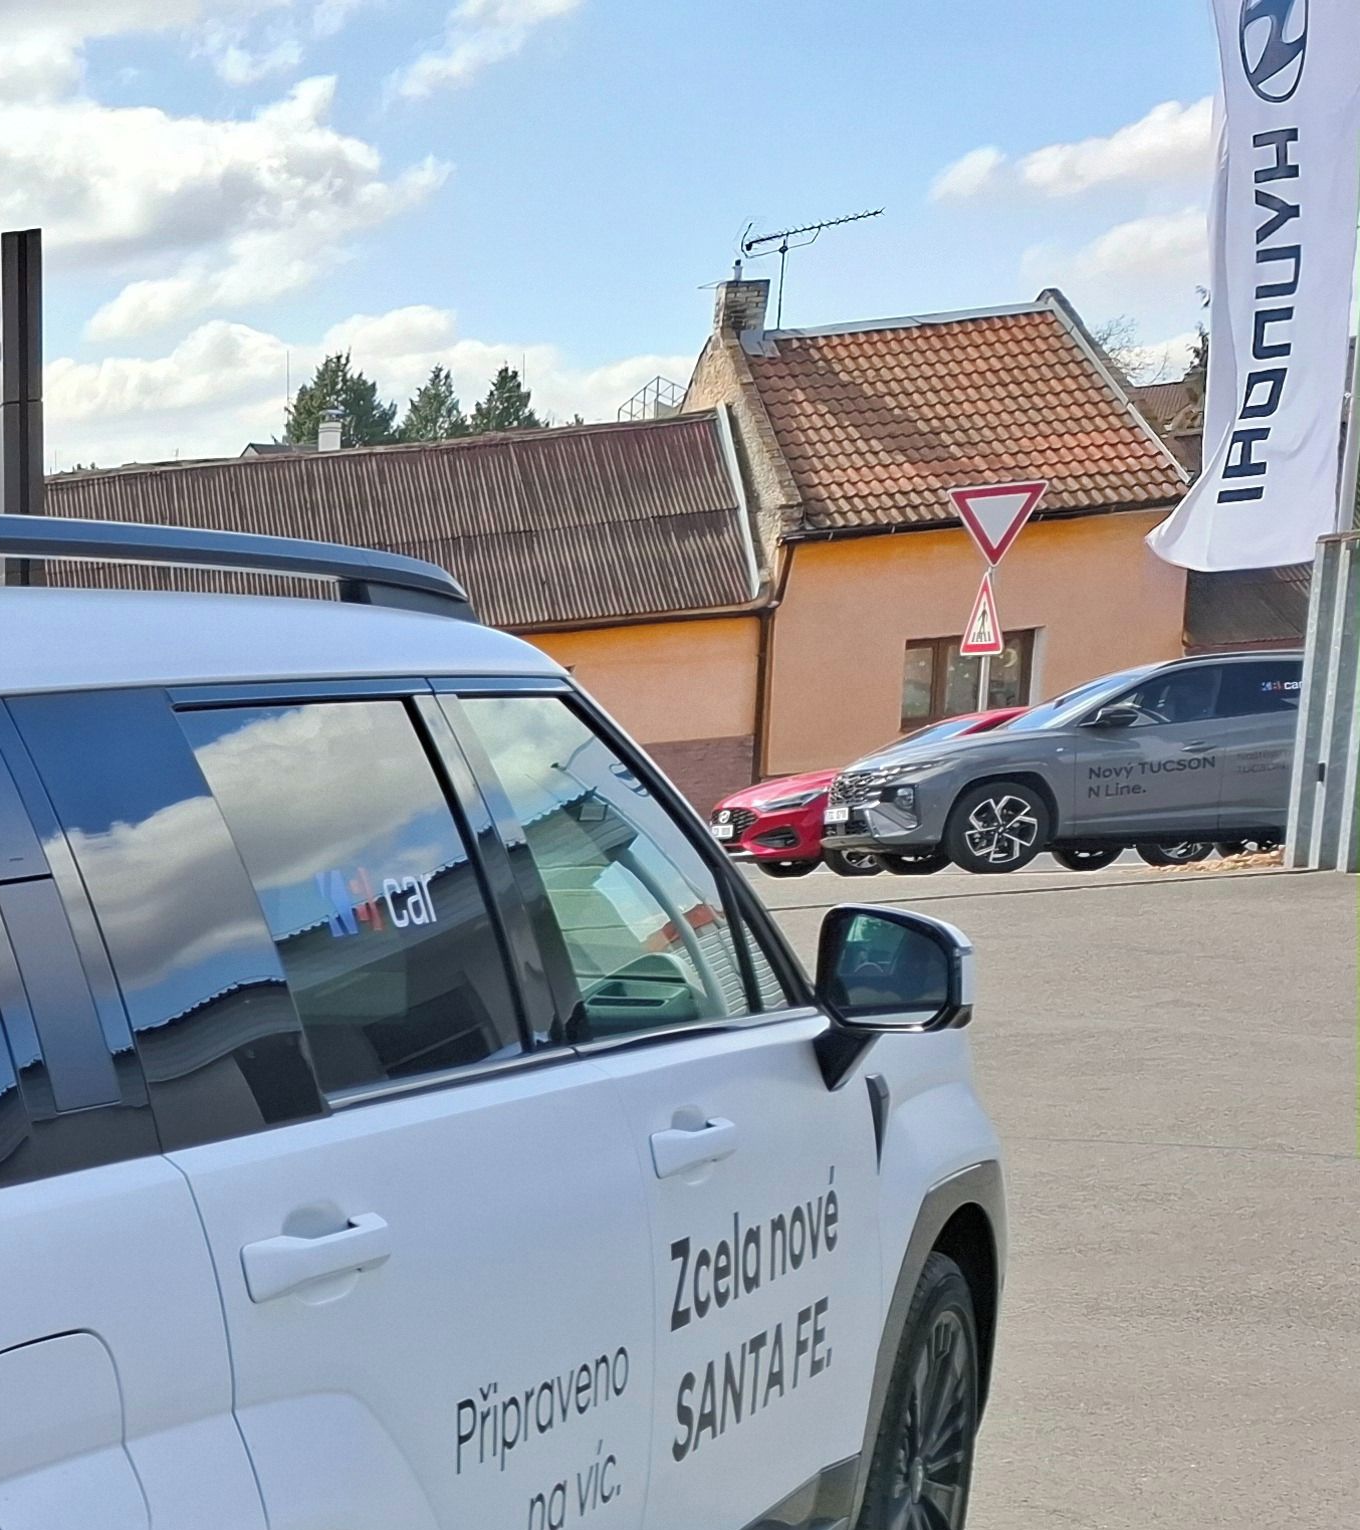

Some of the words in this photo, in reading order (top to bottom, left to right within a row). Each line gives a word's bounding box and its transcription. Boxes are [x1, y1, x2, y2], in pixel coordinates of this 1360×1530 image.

[1088, 762, 1134, 780] Nový
[1137, 755, 1216, 775] TUCSON
[1088, 785, 1101, 799] N
[1105, 781, 1147, 798] Line.
[383, 873, 437, 928] car
[670, 1211, 761, 1332] Zcela
[770, 1165, 839, 1282] nové
[455, 1345, 630, 1476] Připraveno
[671, 1322, 785, 1463] SANTA
[792, 1296, 833, 1390] FE.
[576, 1438, 622, 1518] víc.
